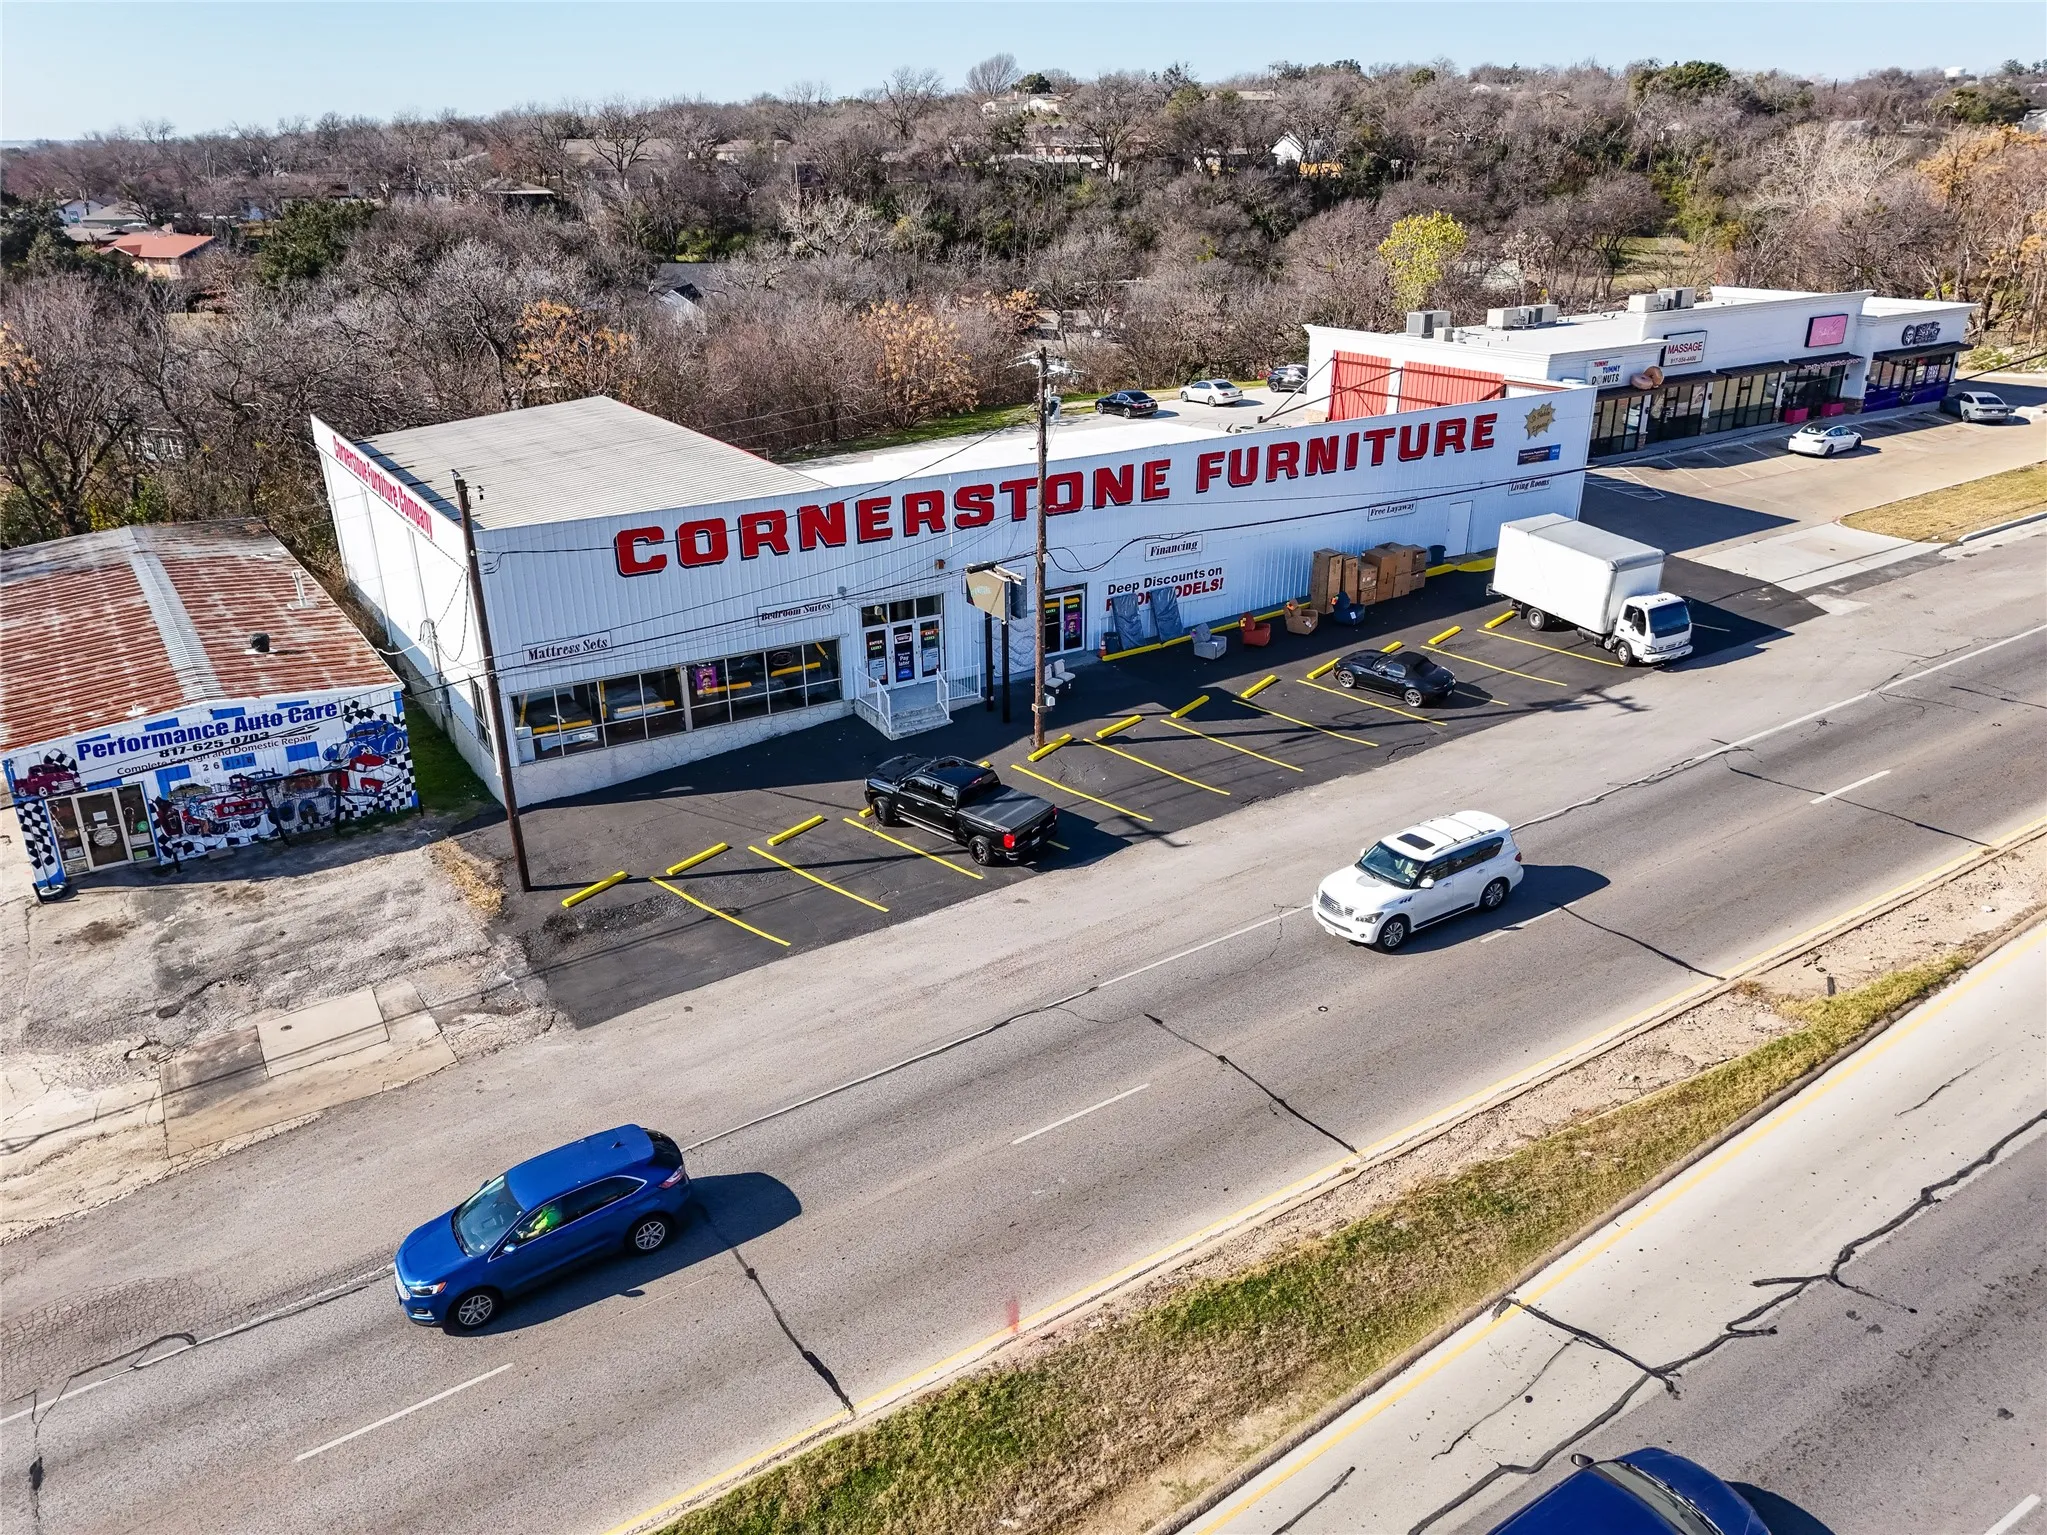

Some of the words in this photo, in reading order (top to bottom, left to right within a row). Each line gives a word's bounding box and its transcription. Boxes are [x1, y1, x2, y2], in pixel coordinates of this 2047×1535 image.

[1668, 341, 1703, 354] MASSAGE
[333, 435, 368, 482] Cornerstone
[367, 462, 398, 508] Furniture
[398, 486, 432, 540] Company
[614, 458, 1171, 577] CORNERSTONE
[1196, 413, 1498, 494] FURNITURE
[1510, 482, 1529, 491] Living
[1530, 479, 1550, 488] Rooms
[1370, 508, 1386, 516] Free
[1387, 503, 1415, 514] Layaway
[1150, 541, 1199, 556] Financing
[1108, 581, 1140, 595] Deep
[1144, 570, 1205, 588] Discounts
[1207, 567, 1223, 577] on
[1174, 578, 1224, 598] ODELS!
[761, 608, 801, 620] Bedroom
[803, 602, 831, 613] Suites
[528, 643, 581, 661] Mattress
[583, 638, 608, 651] Sets
[76, 722, 229, 761] Performance
[234, 712, 283, 733] Auto
[287, 703, 337, 723] Care
[117, 758, 168, 775] Complete
[212, 748, 231, 757] and
[234, 740, 279, 754] Domestic
[282, 734, 312, 746] Repair
[159, 732, 270, 757] 817-625-0703
